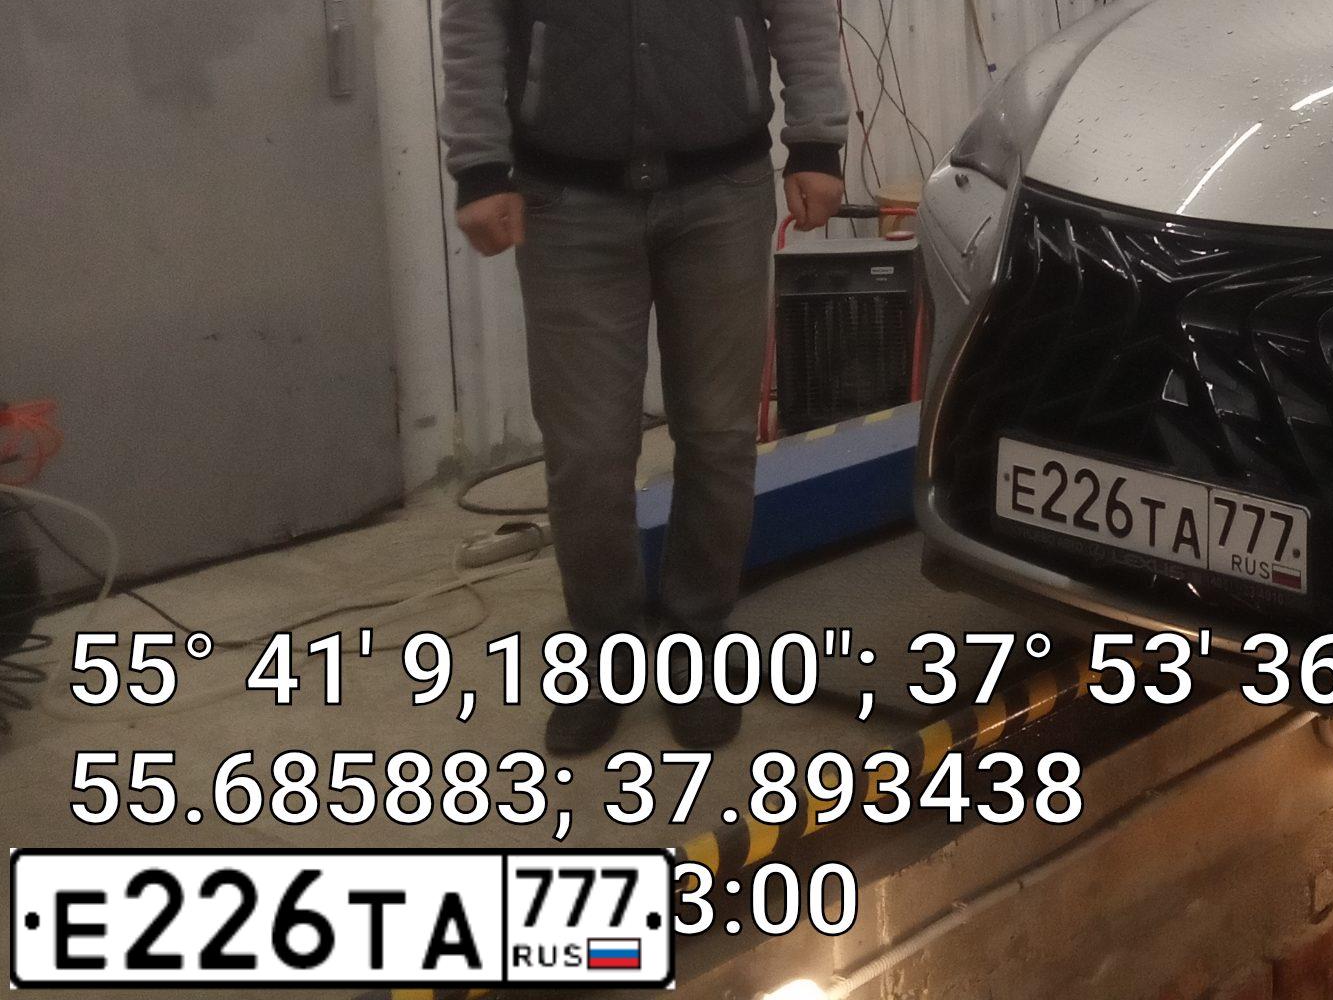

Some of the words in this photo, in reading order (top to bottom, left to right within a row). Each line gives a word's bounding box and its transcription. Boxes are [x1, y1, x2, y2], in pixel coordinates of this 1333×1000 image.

[1011, 460, 1201, 560] E226TA
[1213, 497, 1294, 562] 777
[1230, 554, 1271, 580] RUS
